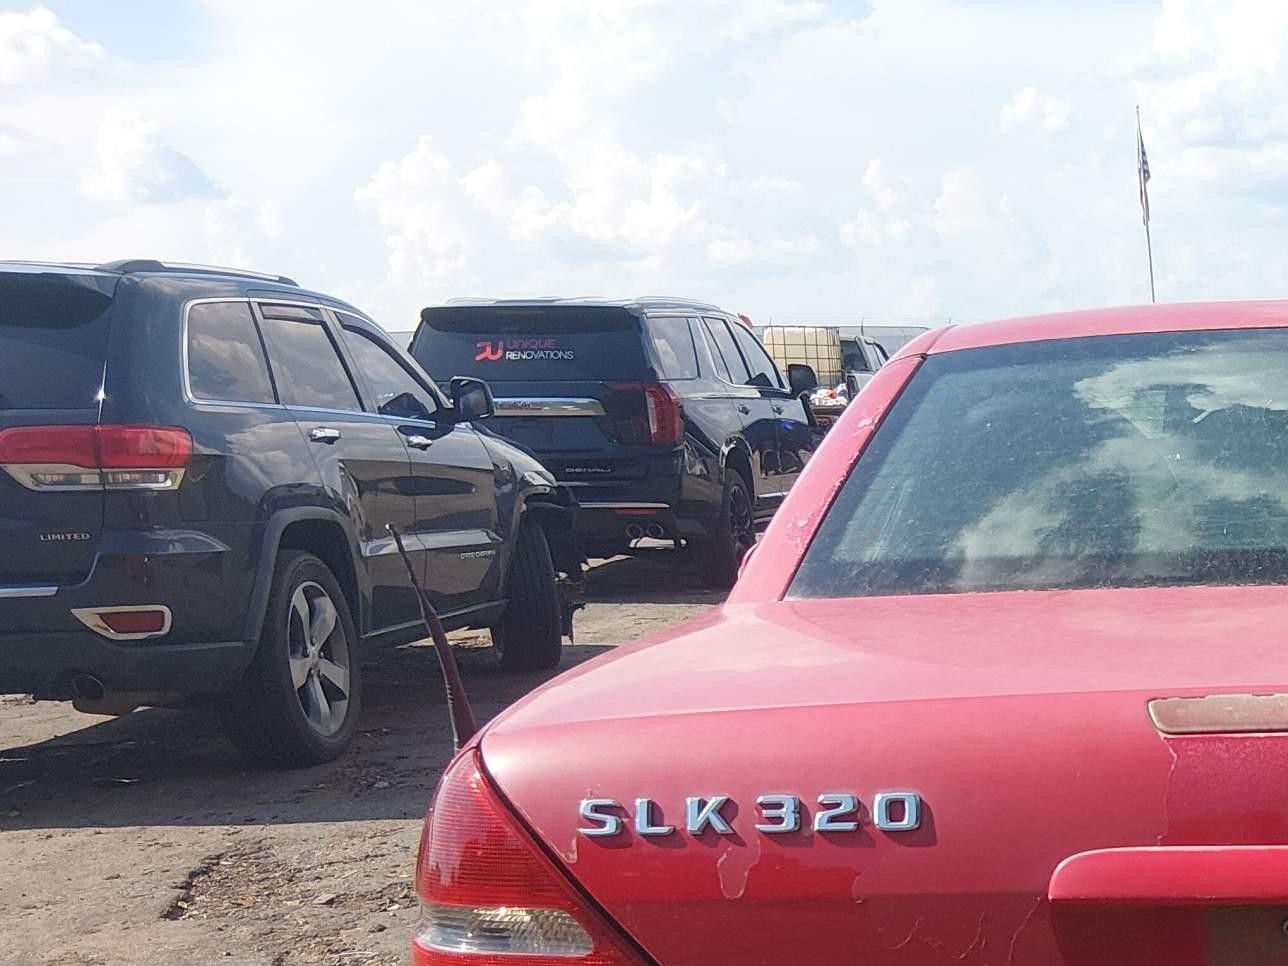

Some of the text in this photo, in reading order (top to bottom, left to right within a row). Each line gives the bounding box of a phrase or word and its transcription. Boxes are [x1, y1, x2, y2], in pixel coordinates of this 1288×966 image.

[505, 350, 574, 360] RENOVATIONS
[40, 533, 90, 541] LIMITED
[578, 791, 921, 836] SLK 320
